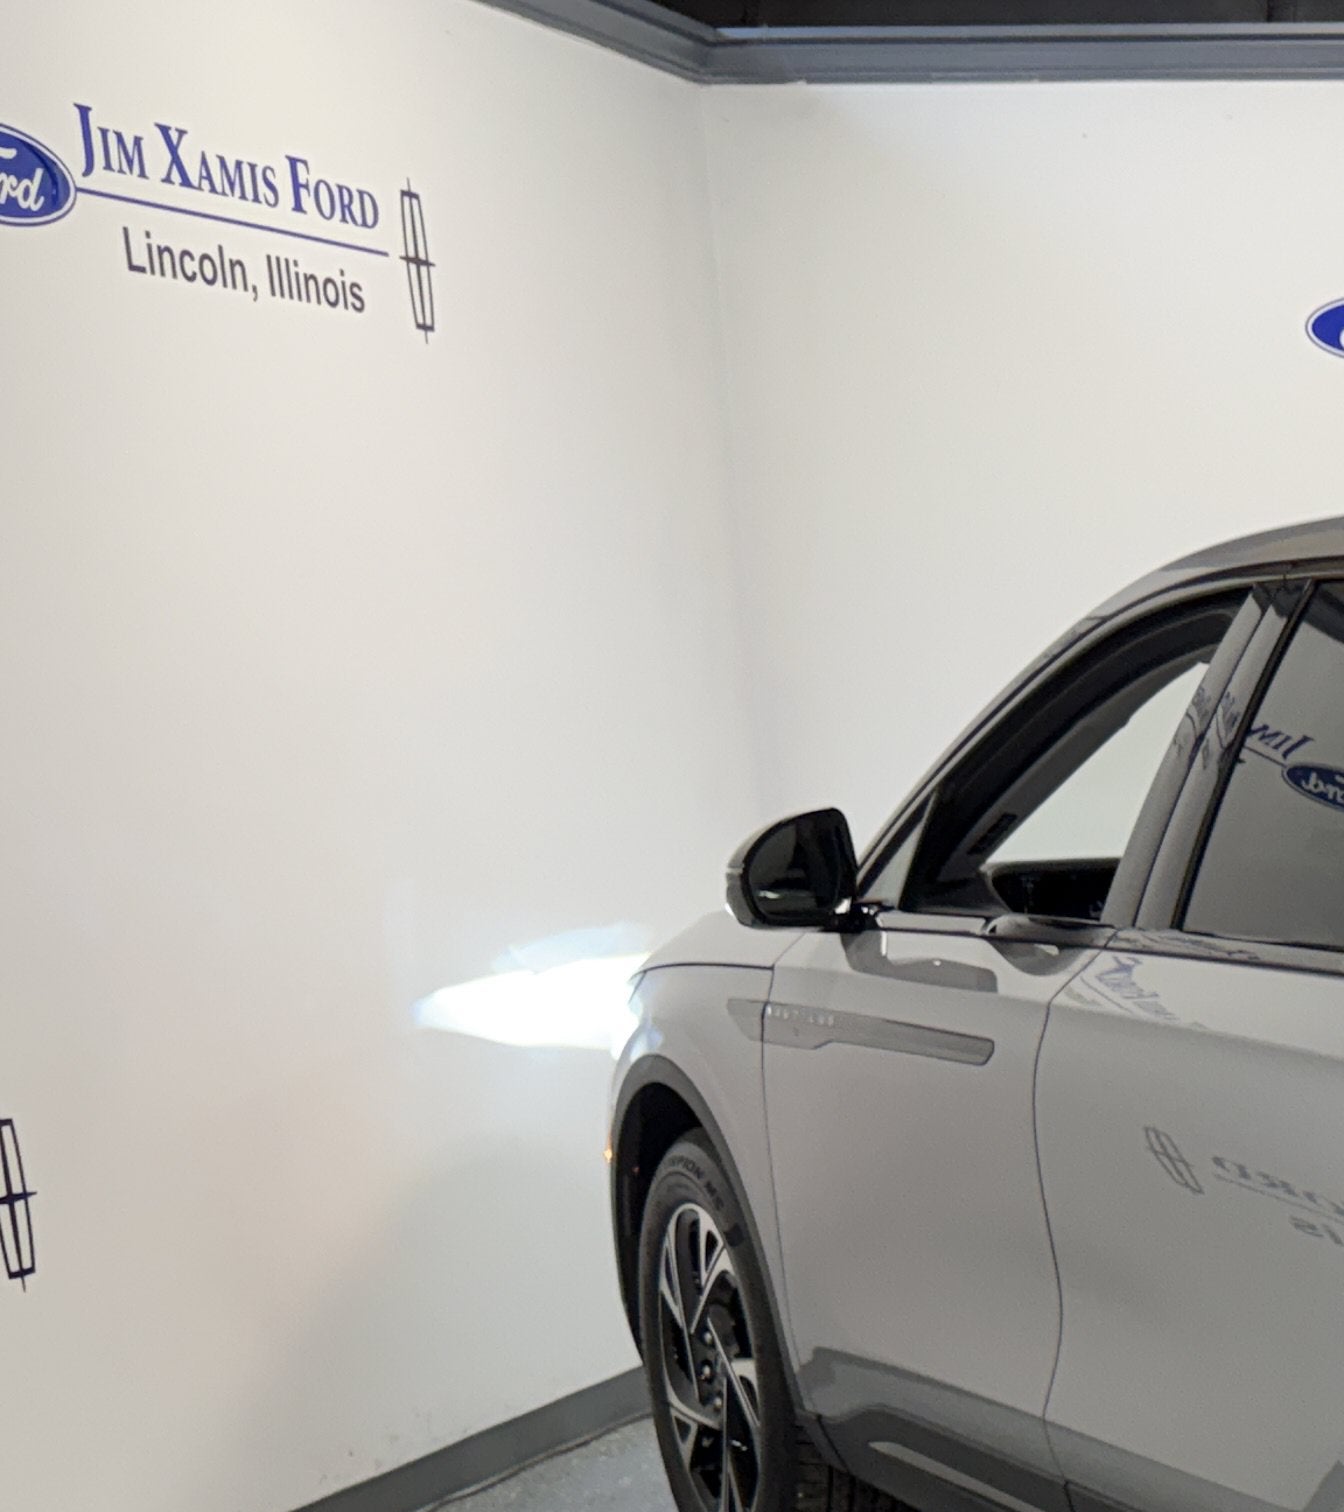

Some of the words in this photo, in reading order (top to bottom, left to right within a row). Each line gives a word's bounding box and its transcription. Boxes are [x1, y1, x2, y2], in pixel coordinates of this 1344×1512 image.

[73, 103, 150, 180] JIM
[154, 121, 279, 208] XAMIS
[285, 154, 379, 229] FORD
[122, 226, 258, 302] Lincoln,
[266, 254, 365, 313] Illinois
